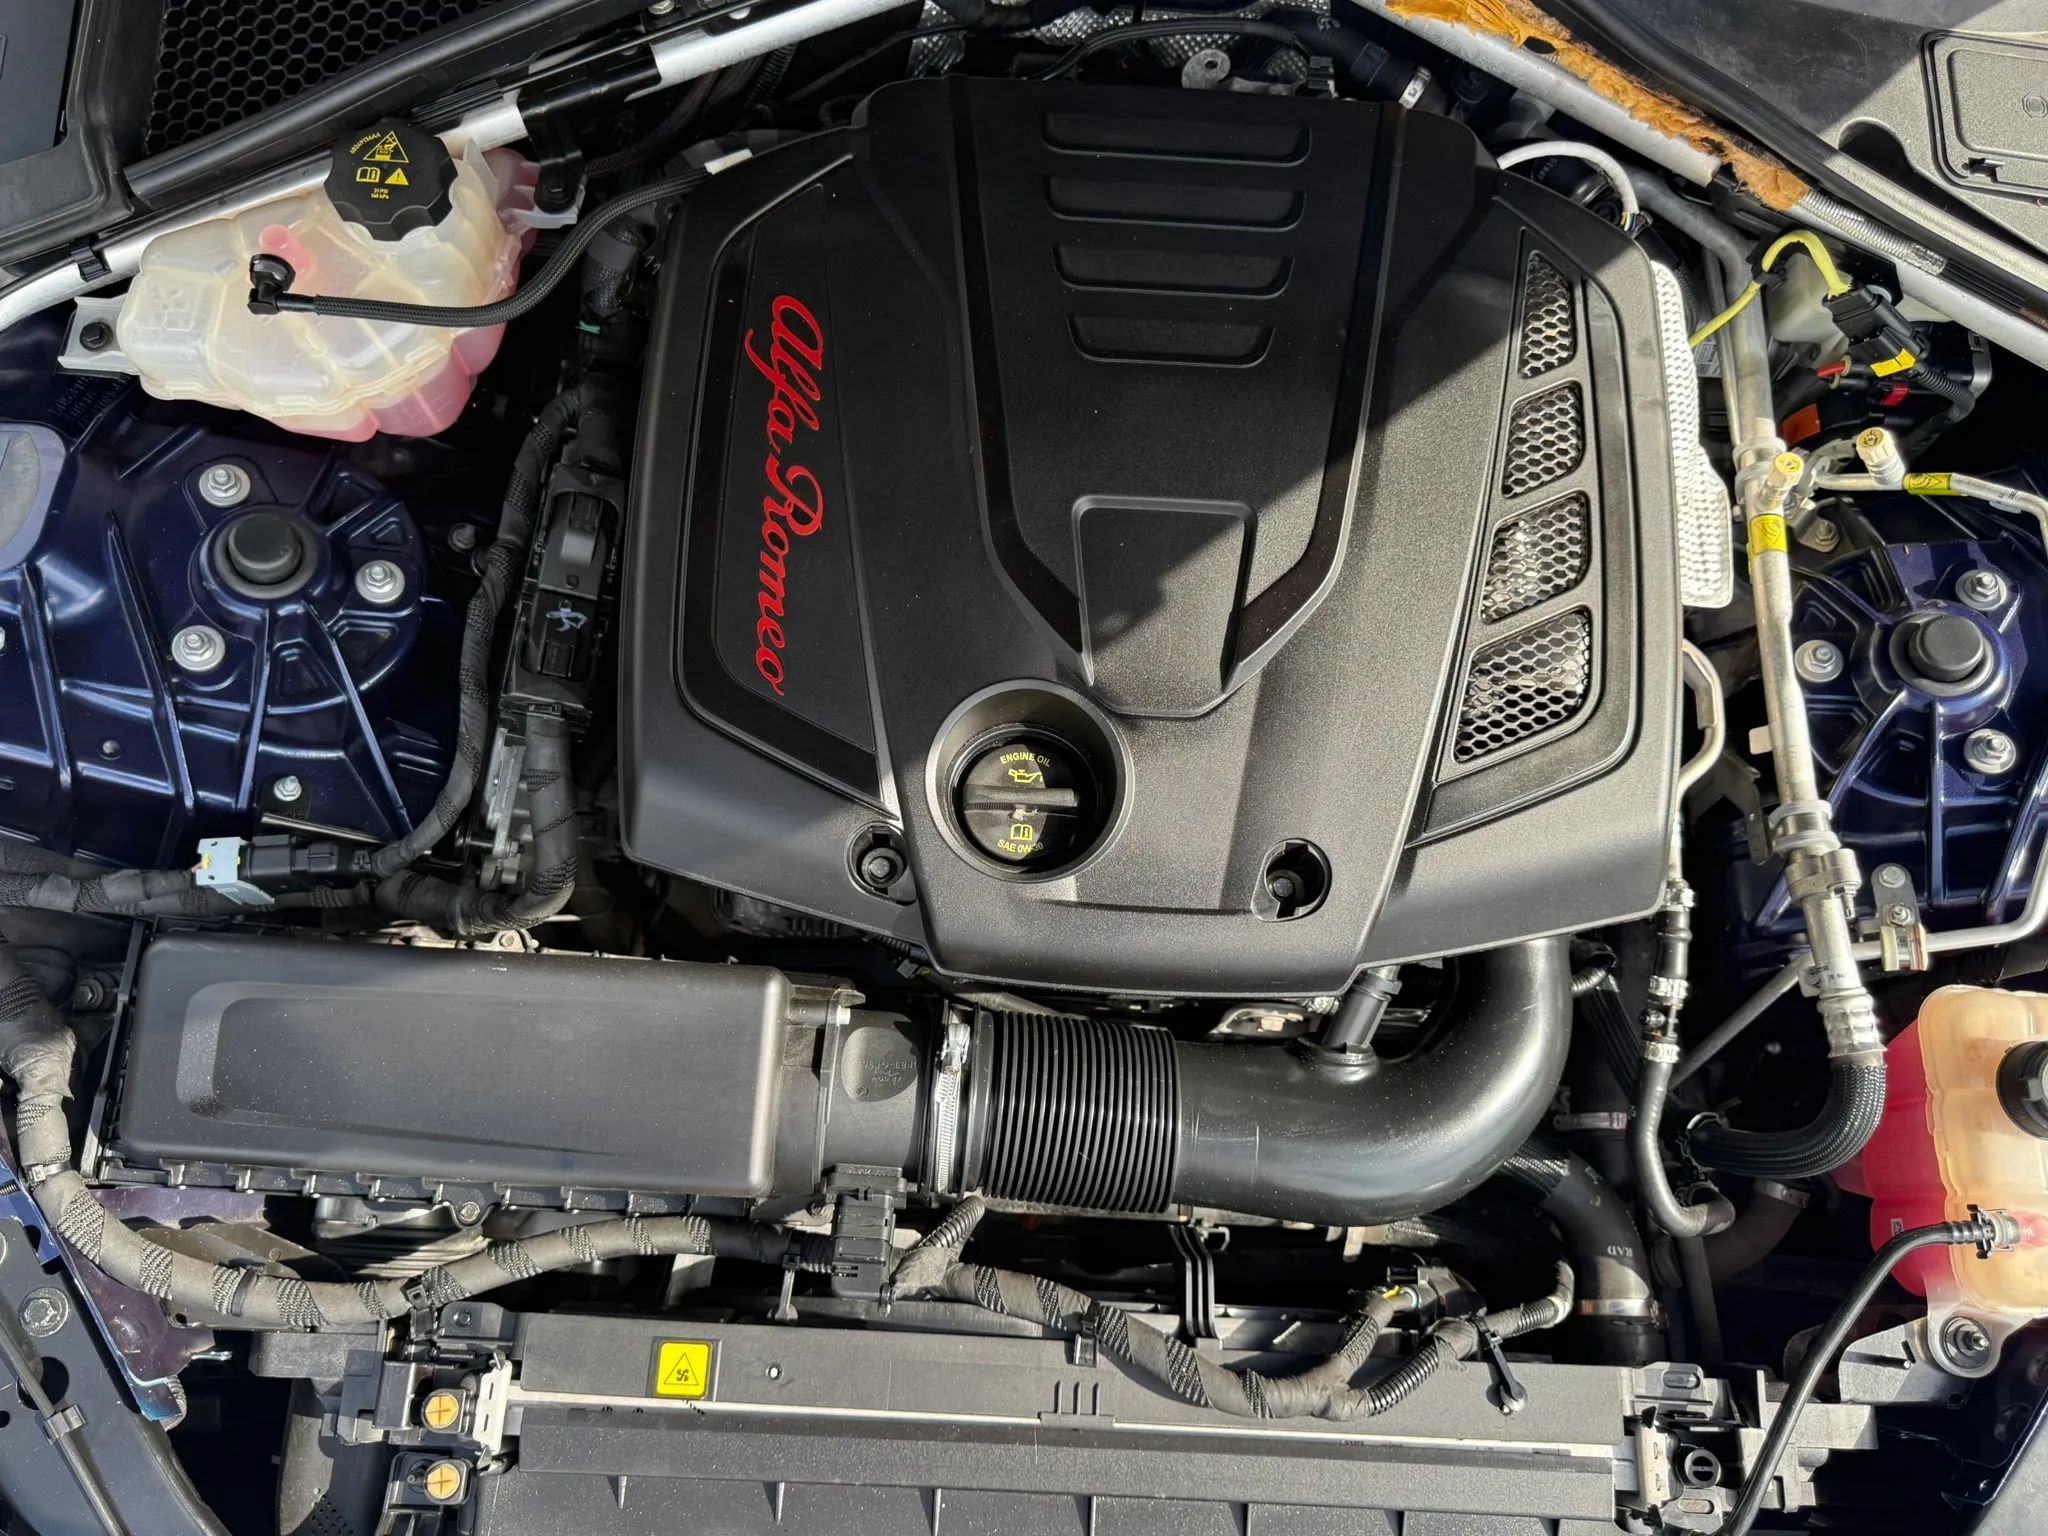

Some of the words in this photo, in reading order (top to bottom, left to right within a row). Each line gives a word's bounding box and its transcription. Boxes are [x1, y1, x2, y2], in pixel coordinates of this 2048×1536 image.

[745, 295, 823, 453] Alfa
[756, 452, 823, 696] Romeo
[1000, 752, 1035, 764] ENGINE
[1037, 755, 1051, 767] OIL
[998, 840, 1016, 853] SAE
[1607, 1245, 1633, 1256] RAD
